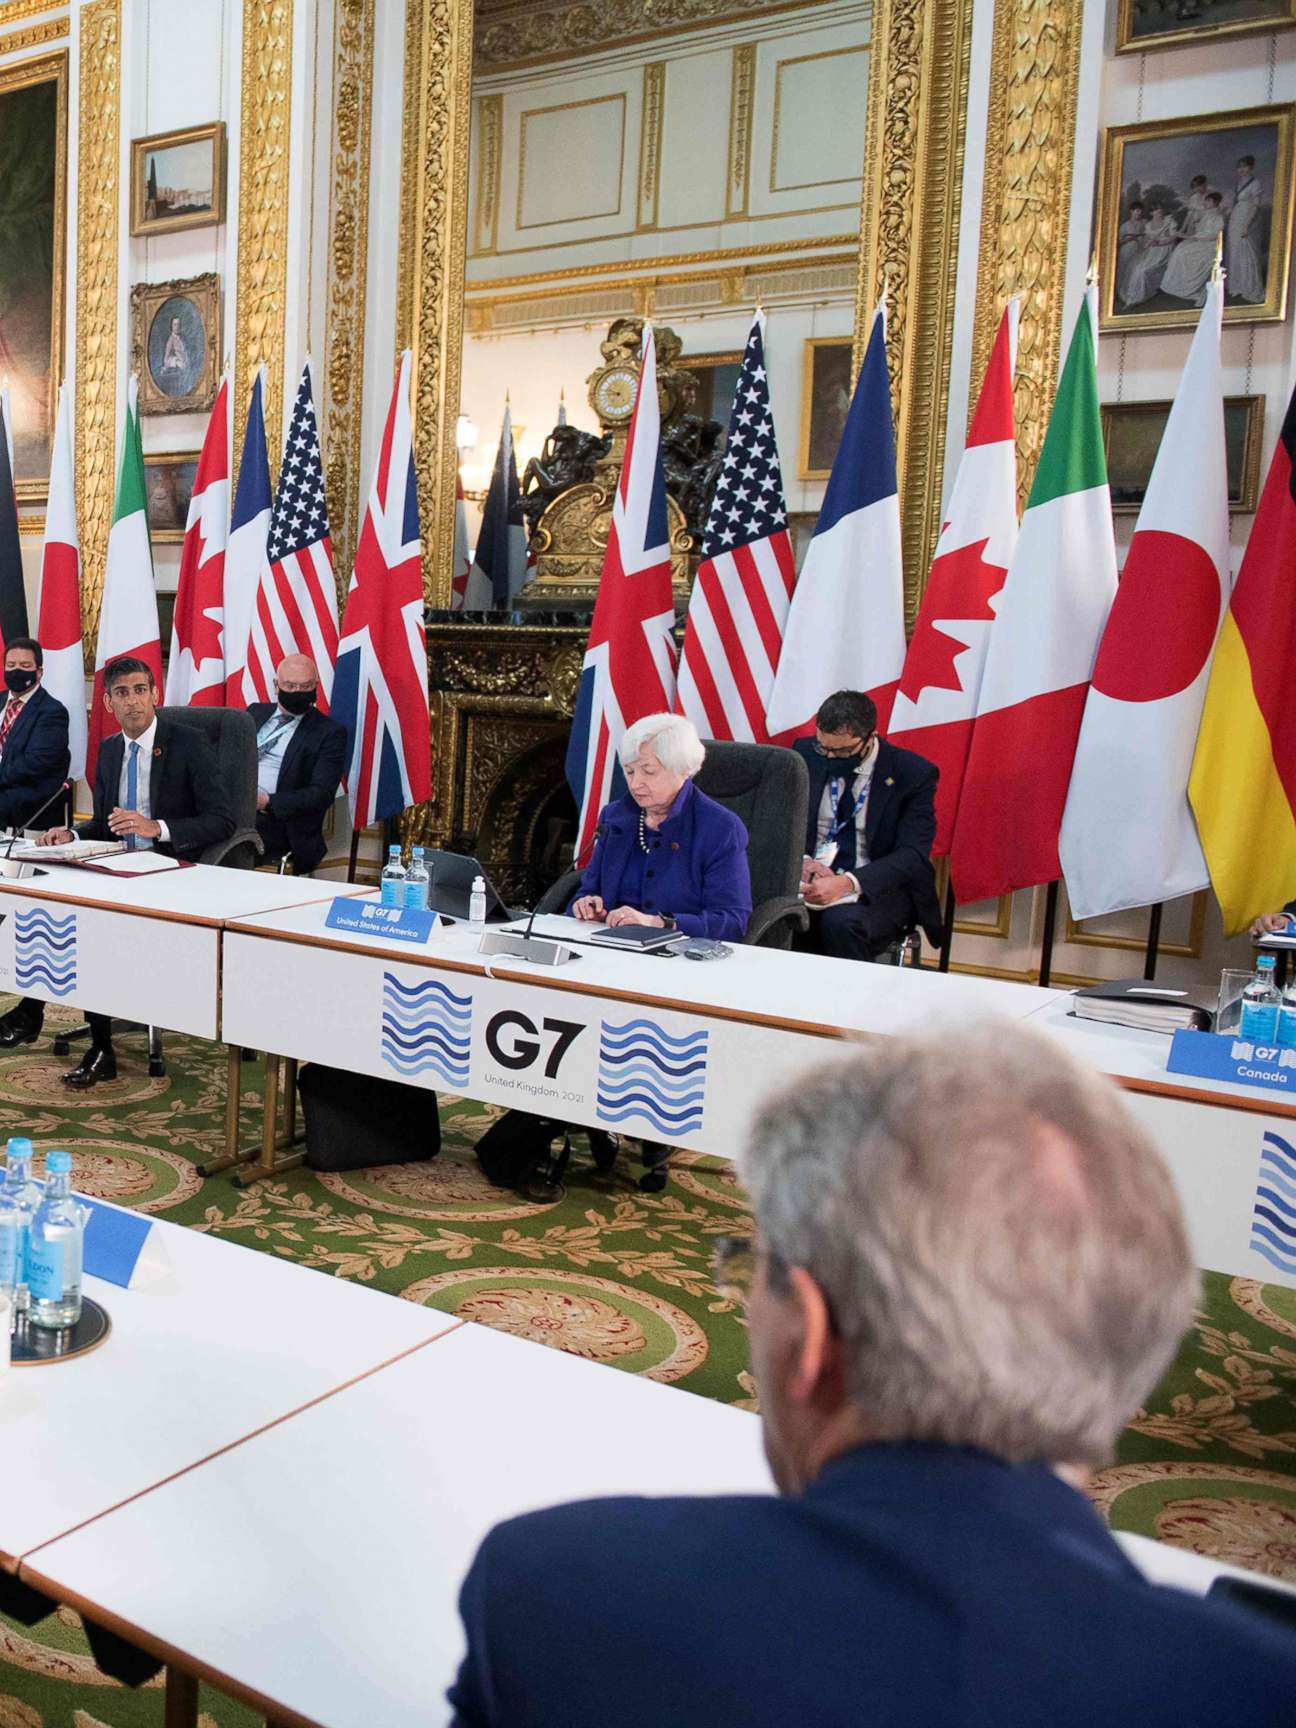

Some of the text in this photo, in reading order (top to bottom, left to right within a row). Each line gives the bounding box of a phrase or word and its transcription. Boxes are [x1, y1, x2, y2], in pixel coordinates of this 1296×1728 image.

[375, 908, 389, 917] G7
[336, 917, 418, 938] United States of America
[486, 1010, 587, 1079] G7
[1255, 1047, 1279, 1060] G7
[1237, 1066, 1288, 1083] Canada
[484, 1074, 585, 1103] United Kingdom 2021
